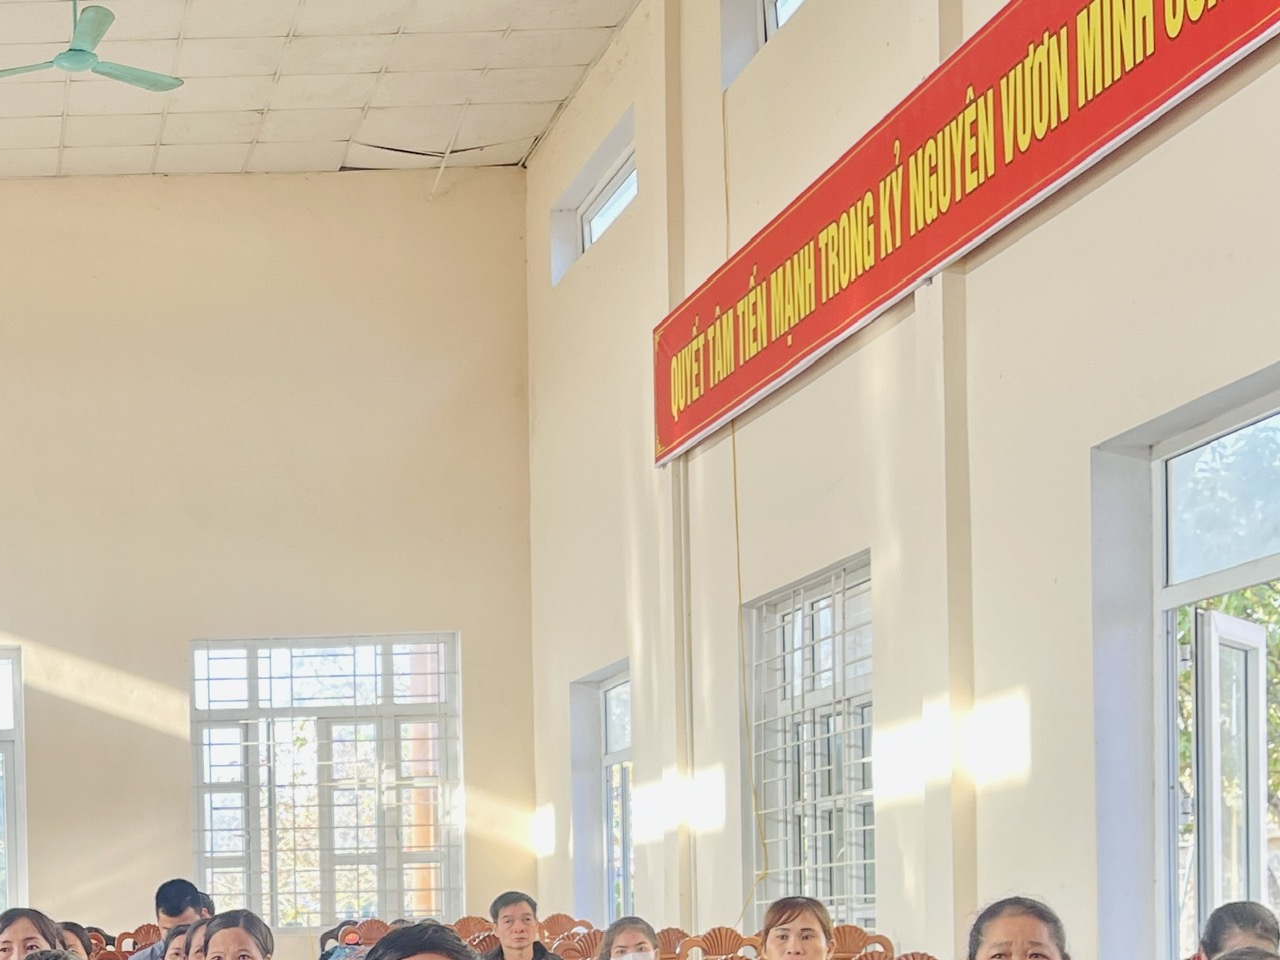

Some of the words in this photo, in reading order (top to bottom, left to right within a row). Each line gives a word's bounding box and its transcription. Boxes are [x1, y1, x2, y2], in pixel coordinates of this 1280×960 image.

[670, 313, 706, 422] QUYẾT
[707, 303, 735, 389] TÂM
[737, 263, 768, 367] TIẾN
[770, 240, 816, 348] MẠNH
[818, 191, 876, 304] TRONG
[879, 139, 904, 260] KỶ
[909, 85, 996, 237] NGUYÊN
[1000, 22, 1069, 165] VƯƠN
